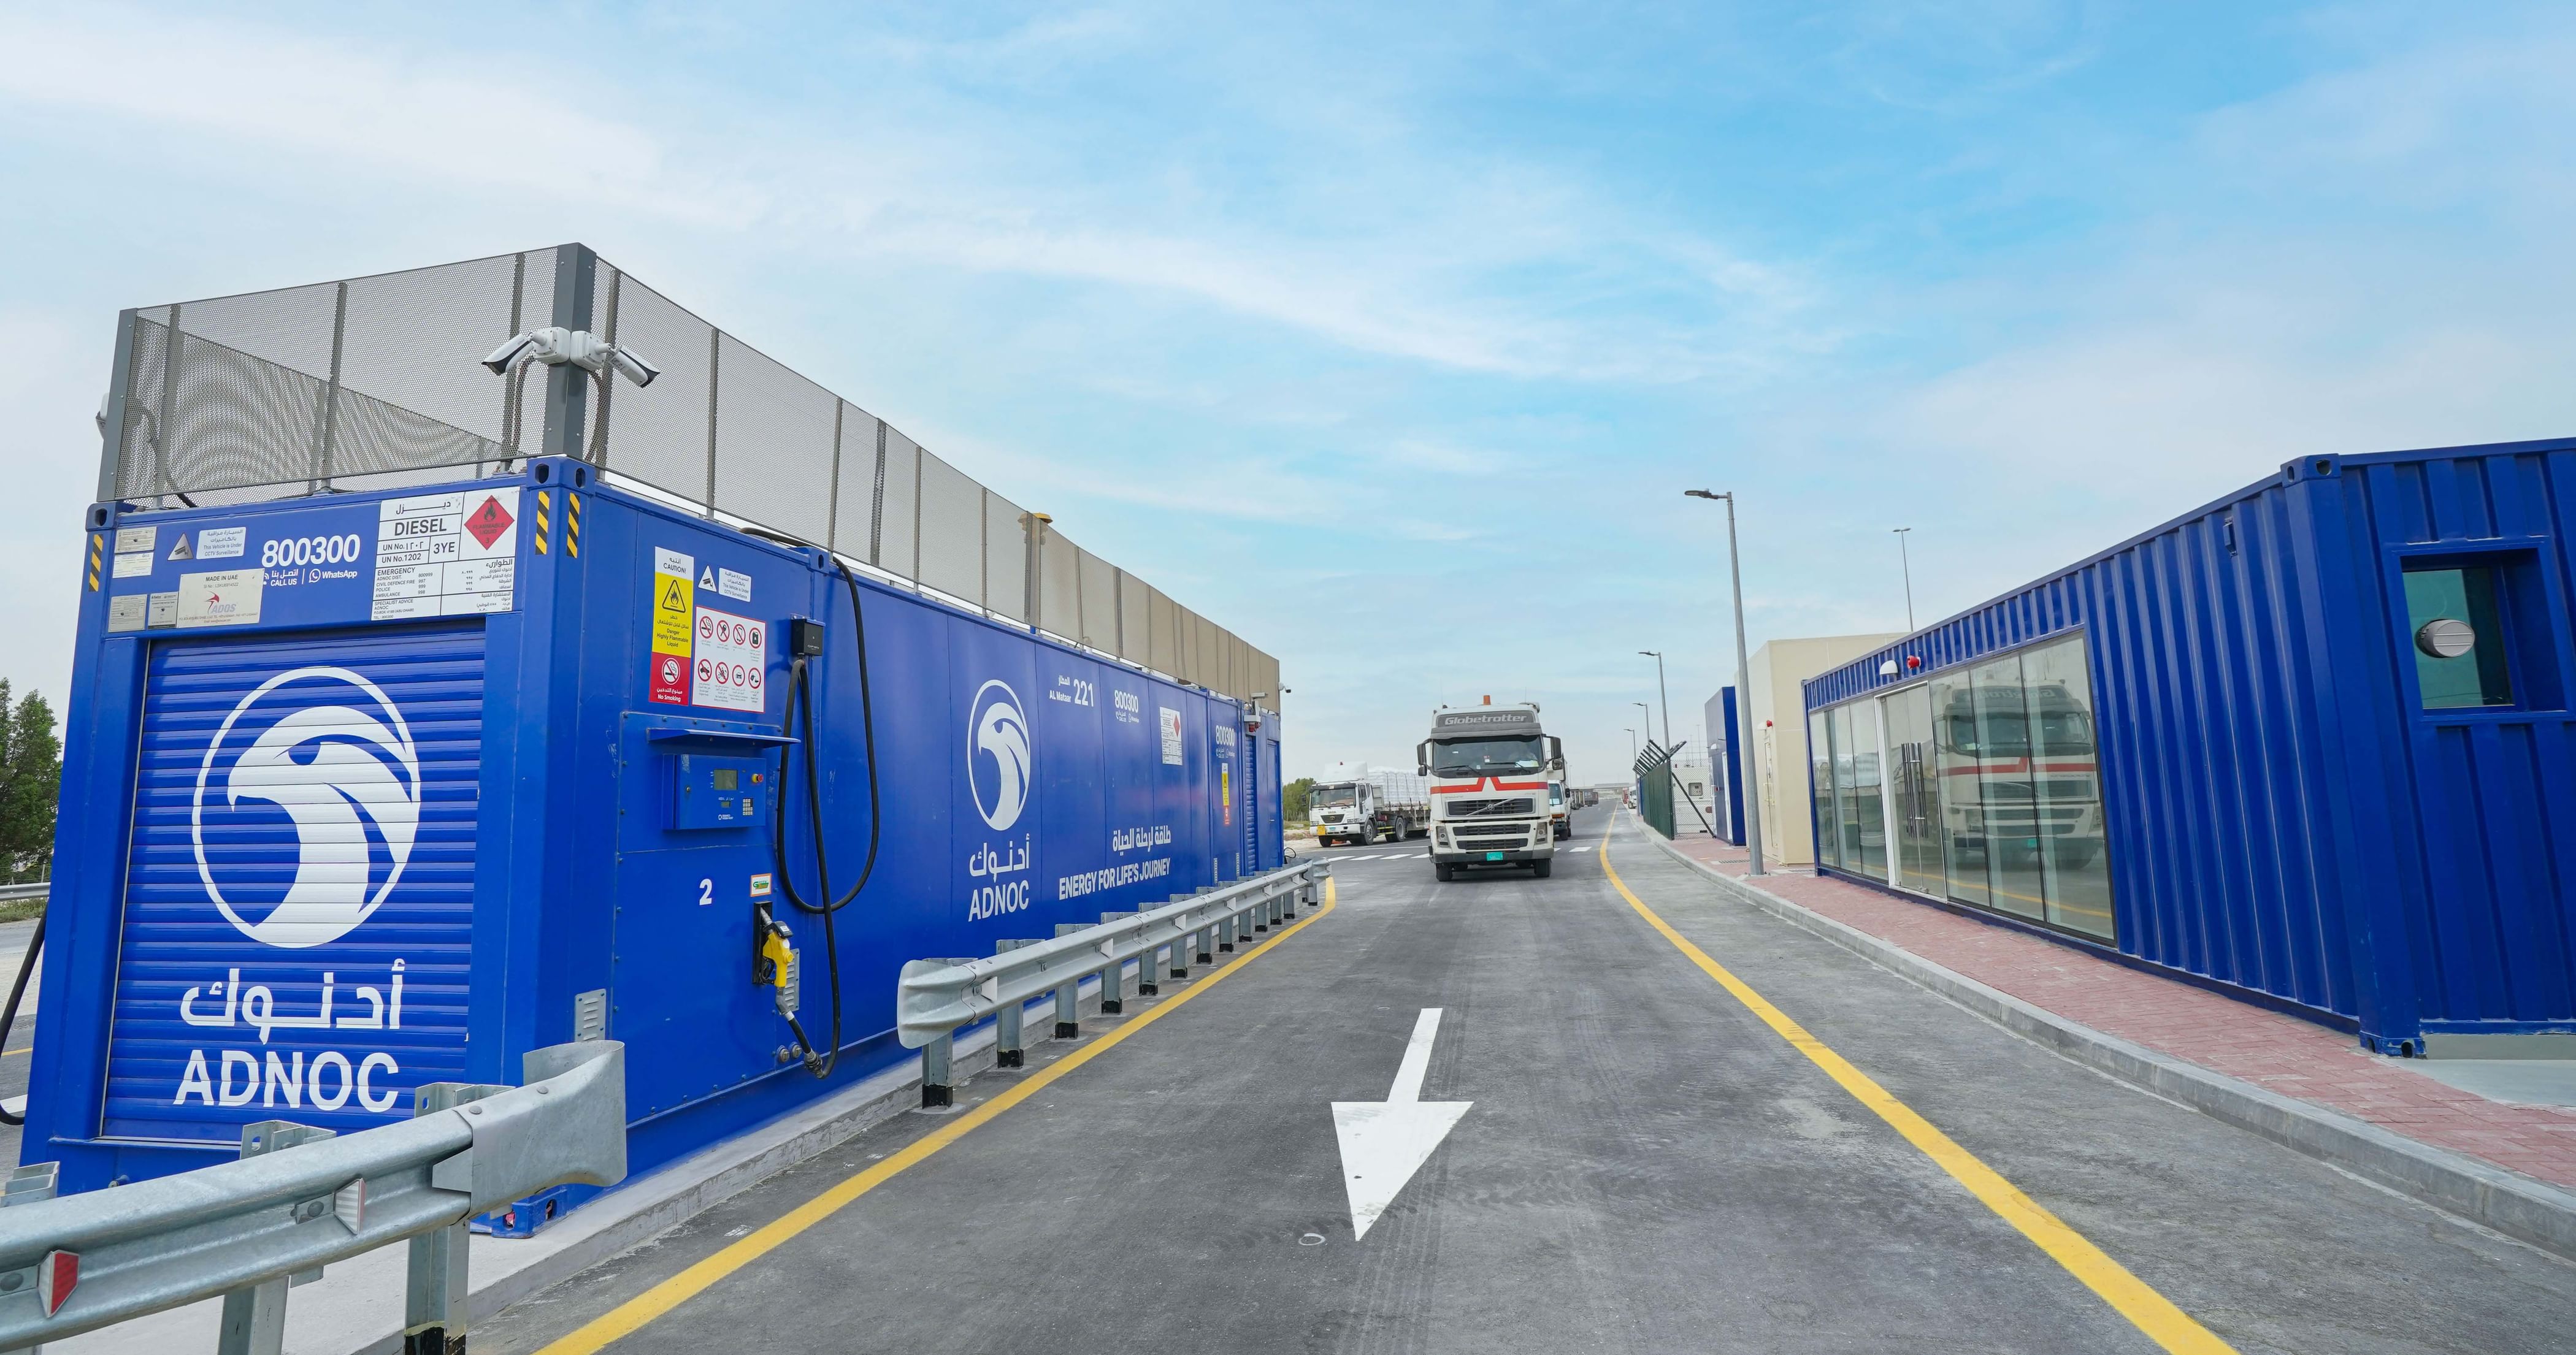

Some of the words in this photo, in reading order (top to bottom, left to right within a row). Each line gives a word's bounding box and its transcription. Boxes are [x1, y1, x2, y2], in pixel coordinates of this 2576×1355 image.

[394, 518, 447, 536] DIESEL
[261, 534, 361, 568] 800300
[433, 541, 455, 554] 3YE
[271, 570, 280, 579] بنا
[280, 568, 299, 579] اتصل
[322, 570, 358, 579] WhatsApp
[377, 567, 415, 576] EMERGENCY
[663, 563, 686, 574] CAUTION!
[211, 603, 237, 614] ADOS
[664, 694, 681, 703] Smoking
[1049, 689, 1056, 700] AL
[1056, 690, 1071, 703] Mataar
[1073, 678, 1094, 707] 221
[1114, 689, 1139, 713] 800300
[1444, 714, 1527, 725] Globetrotter
[1216, 725, 1235, 747] 800300
[1113, 828, 1135, 856] الحياة
[1135, 826, 1154, 852] لرحلة
[1154, 825, 1171, 845] طاقة
[969, 833, 1030, 884] أدنوك
[1059, 871, 1097, 901] ENERGY
[1098, 868, 1116, 891] FOR
[1116, 863, 1139, 887] LIFE'S
[1140, 858, 1171, 881] JOURNEY
[699, 878, 713, 906] 2
[968, 880, 1029, 922] ADNOC
[180, 958, 405, 1045] أدنوك
[173, 1049, 399, 1113] ADNOC
